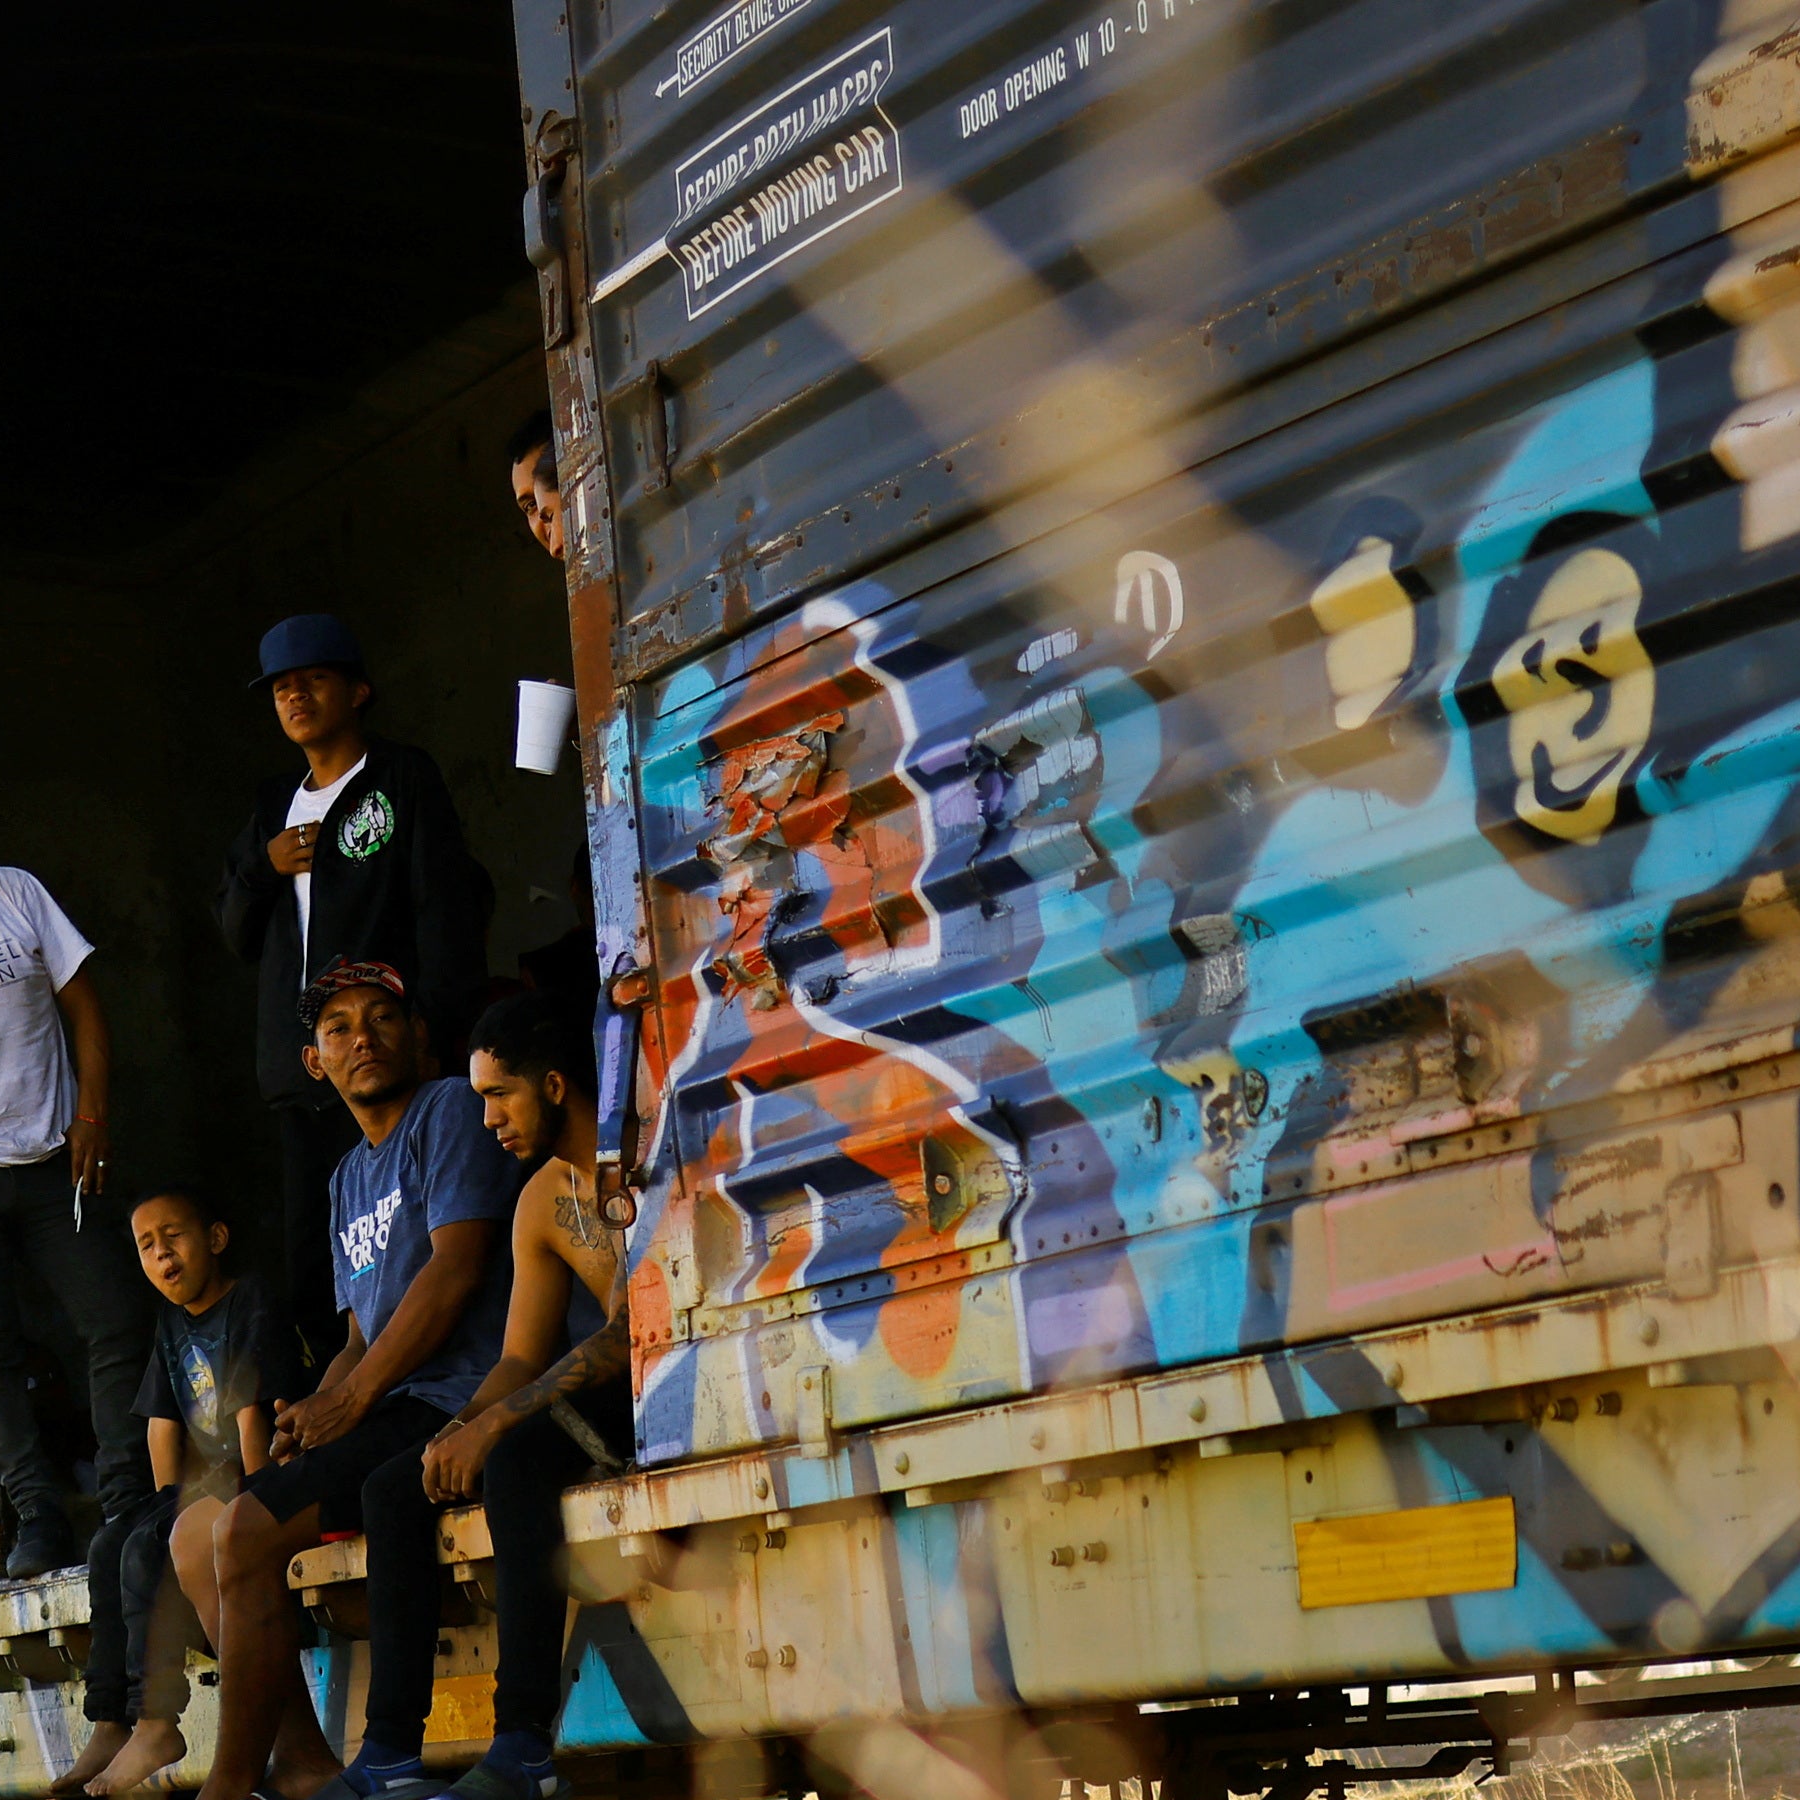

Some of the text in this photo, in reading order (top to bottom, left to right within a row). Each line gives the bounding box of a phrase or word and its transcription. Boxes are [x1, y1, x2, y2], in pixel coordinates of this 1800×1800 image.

[681, 0, 775, 85] SECURITY DEVICE
[960, 88, 999, 139] DOOR
[1004, 47, 1067, 111] OPENING
[1075, 32, 1090, 70] W
[675, 59, 883, 227] SECURE BOTH HASPS
[680, 126, 888, 291] BEFORE MOVING CAR
